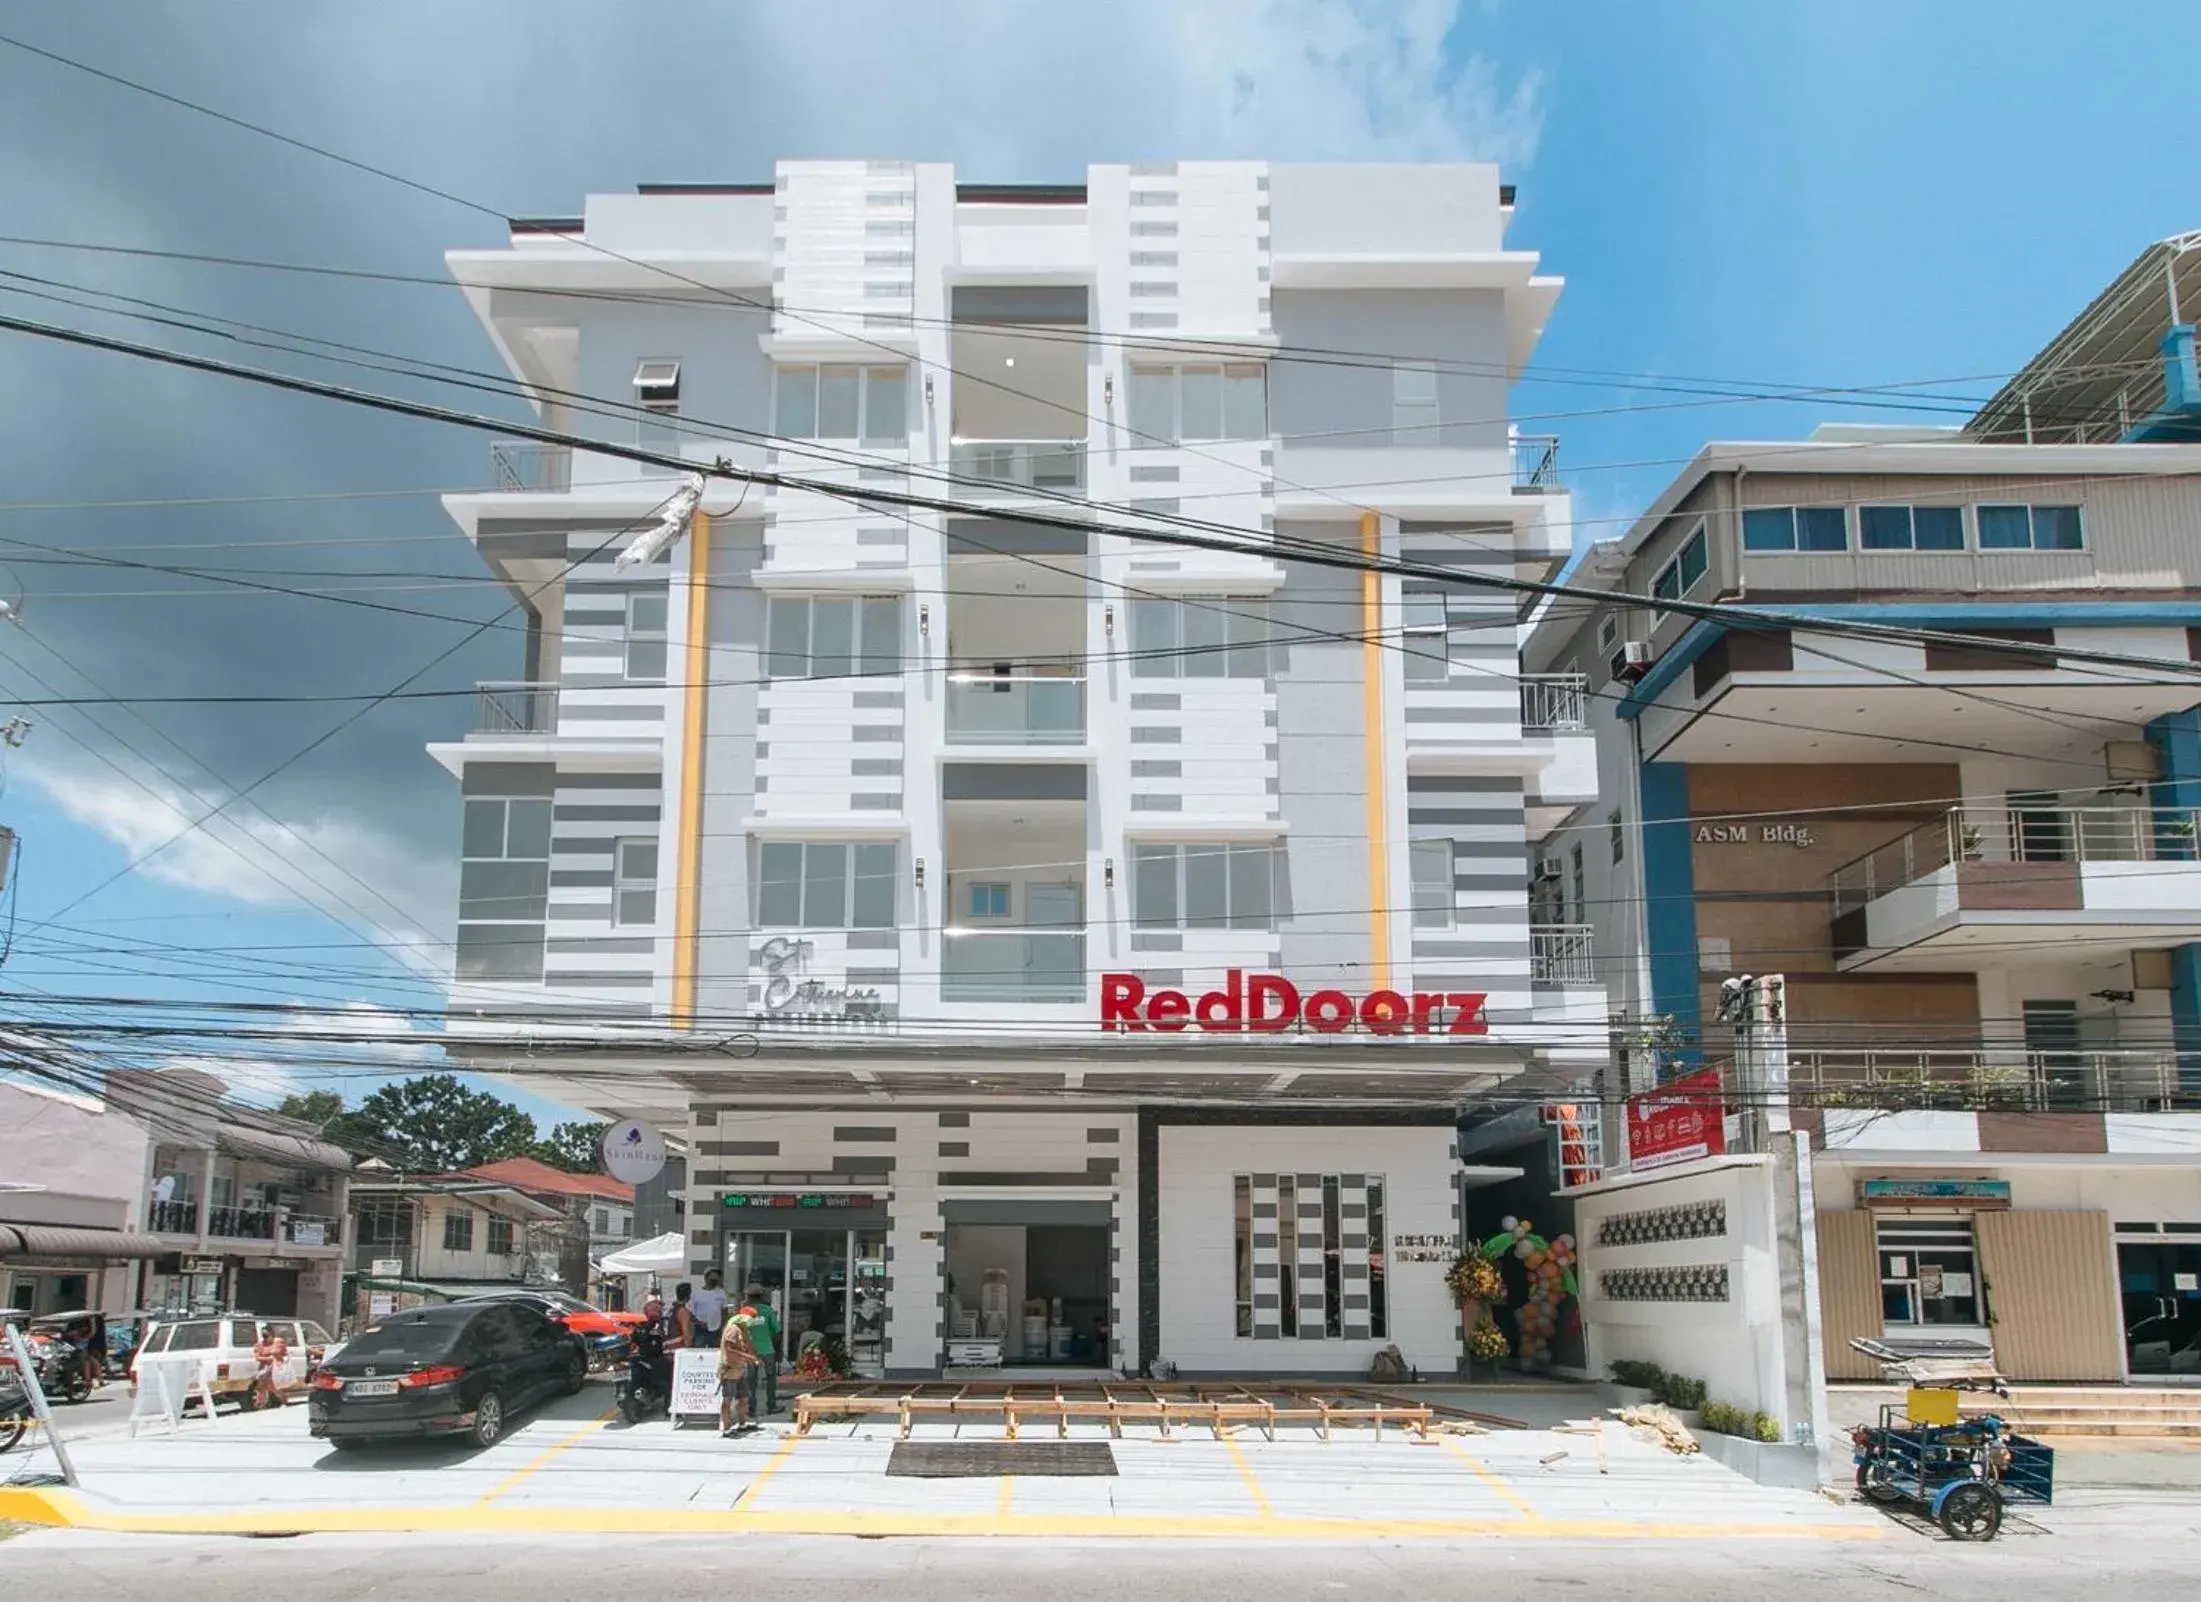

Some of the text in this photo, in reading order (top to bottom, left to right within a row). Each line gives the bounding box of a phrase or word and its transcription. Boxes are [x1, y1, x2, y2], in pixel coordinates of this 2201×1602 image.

[1696, 825, 1815, 847] ASM Bldg.
[1100, 969, 1489, 1036] RedDoorz
